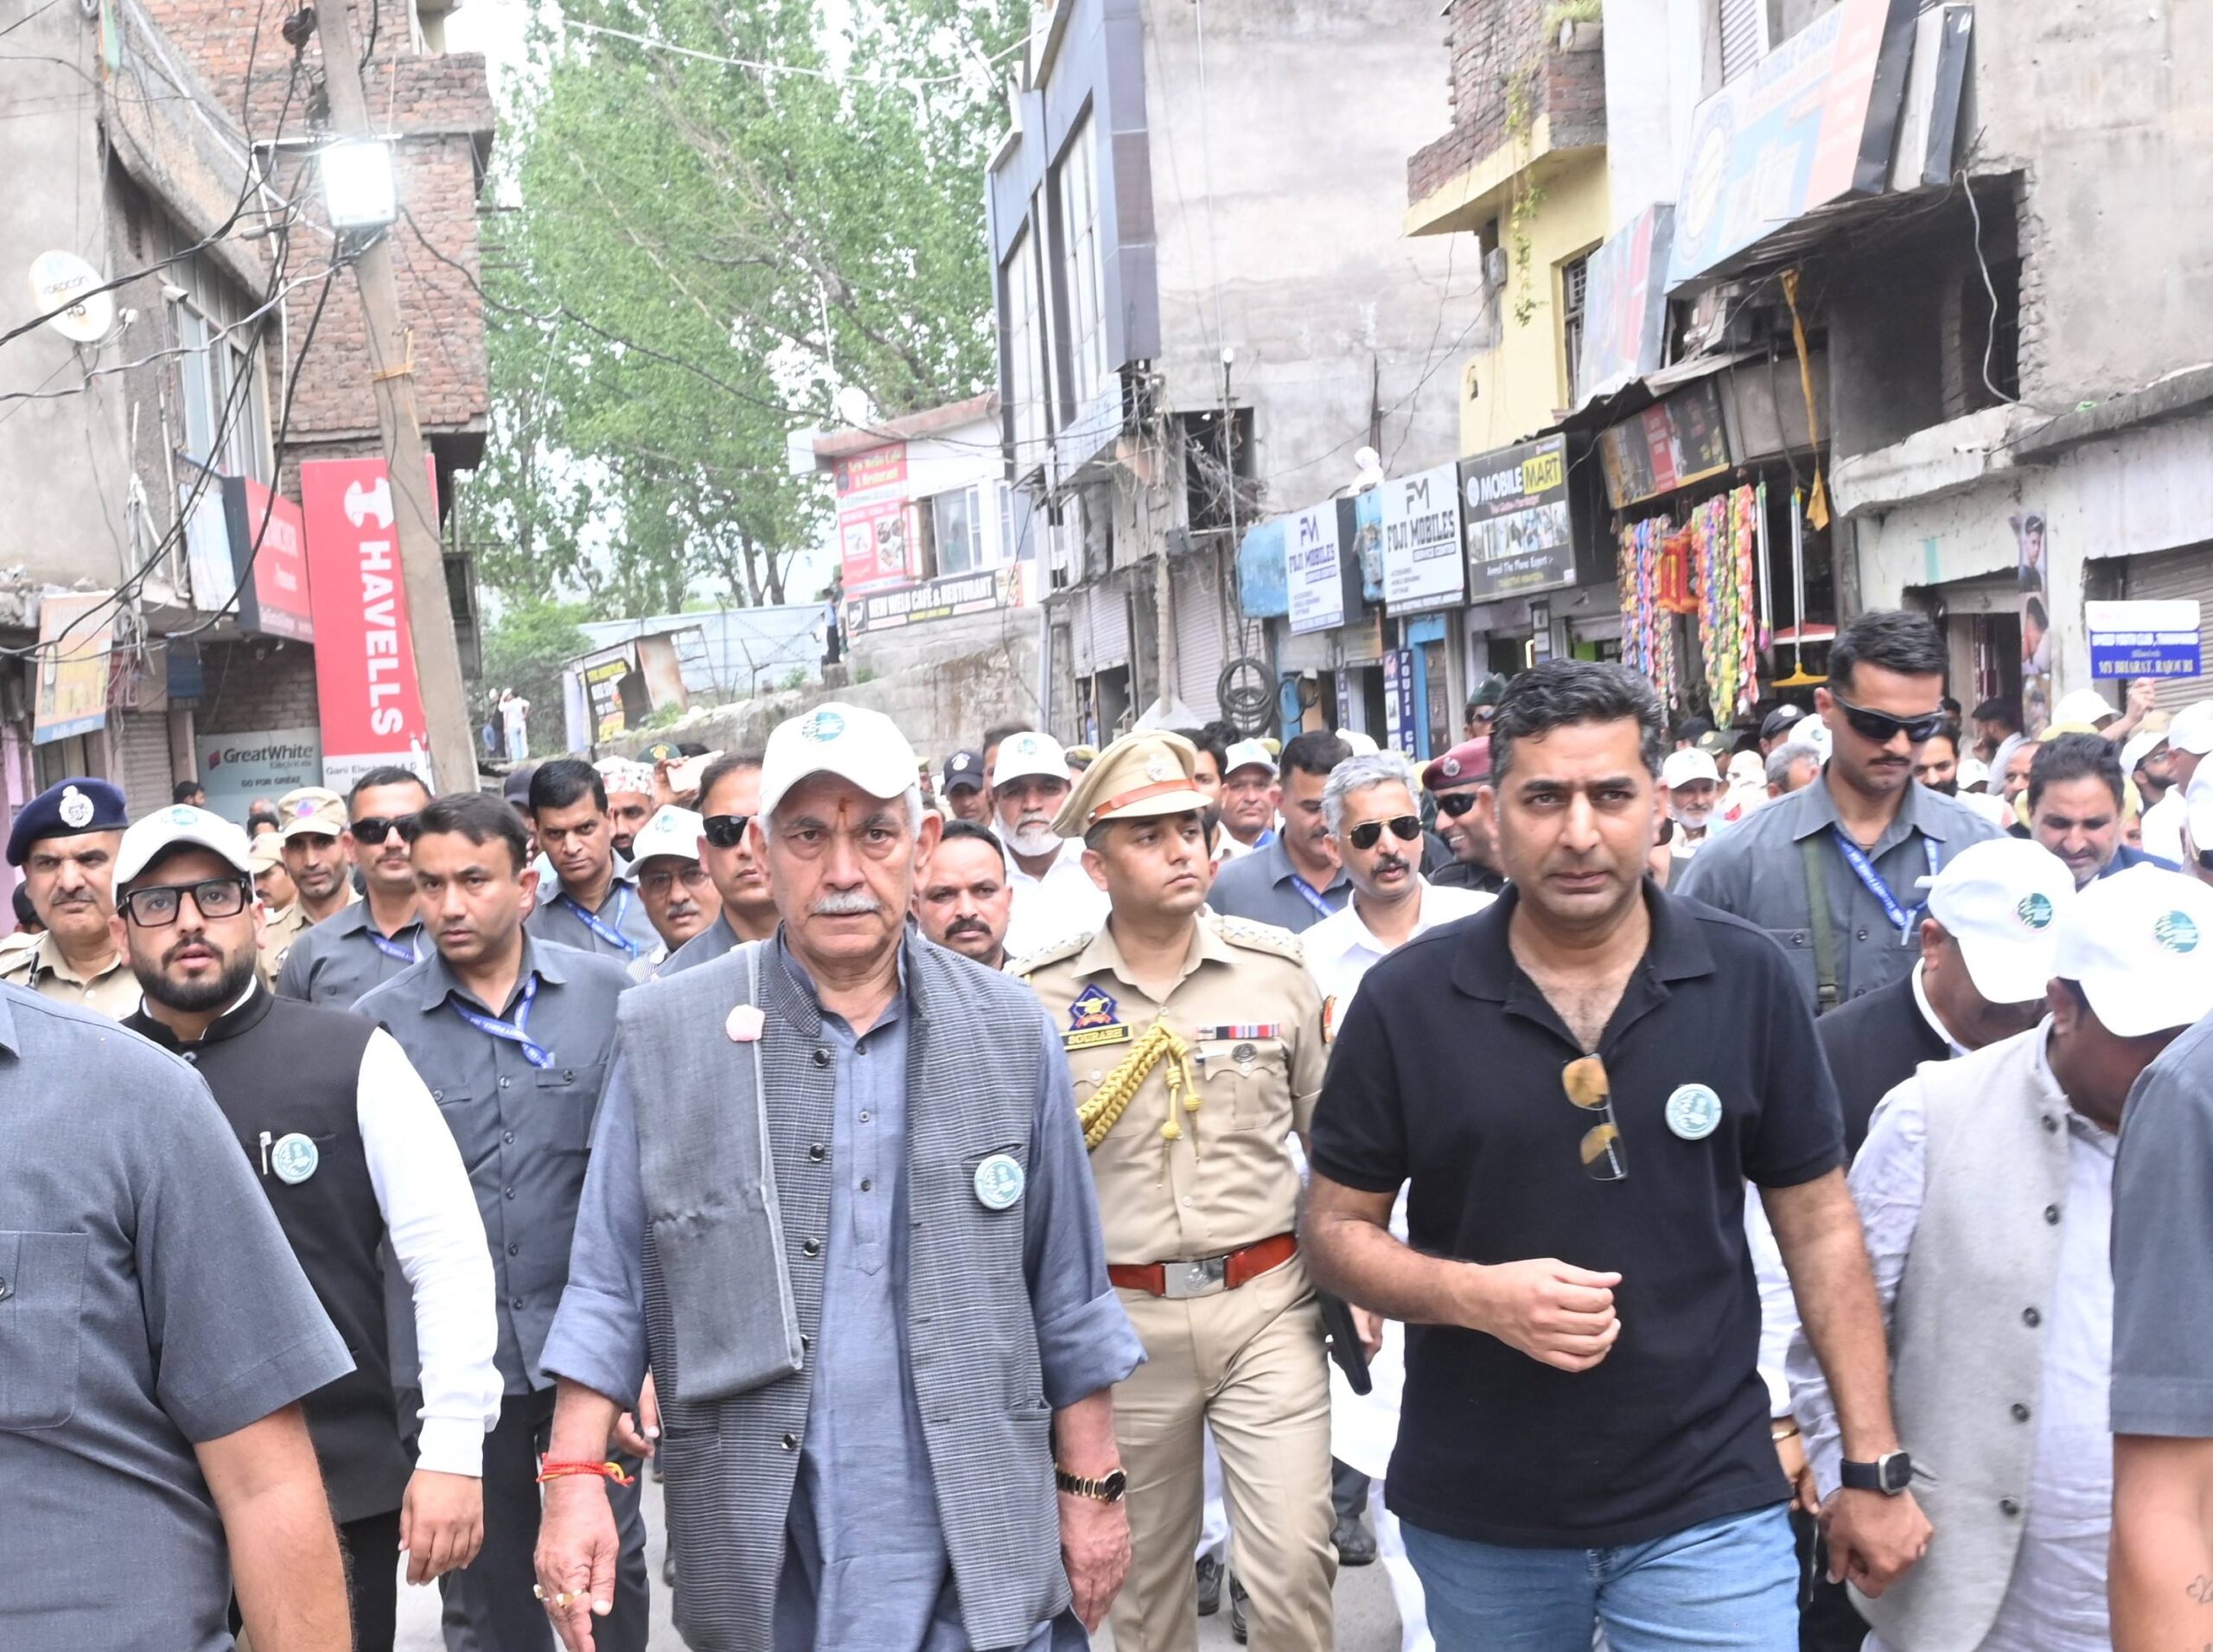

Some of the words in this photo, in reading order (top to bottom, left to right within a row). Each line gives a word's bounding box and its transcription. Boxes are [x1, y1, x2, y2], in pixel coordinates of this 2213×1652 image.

[1481, 467, 1523, 501] MOBILE
[1526, 457, 1559, 489] MART
[1411, 509, 1456, 547] MOBILES
[359, 540, 405, 736] HAVELLS
[223, 743, 313, 763] GreatWhite
[256, 778, 271, 787] FOR
